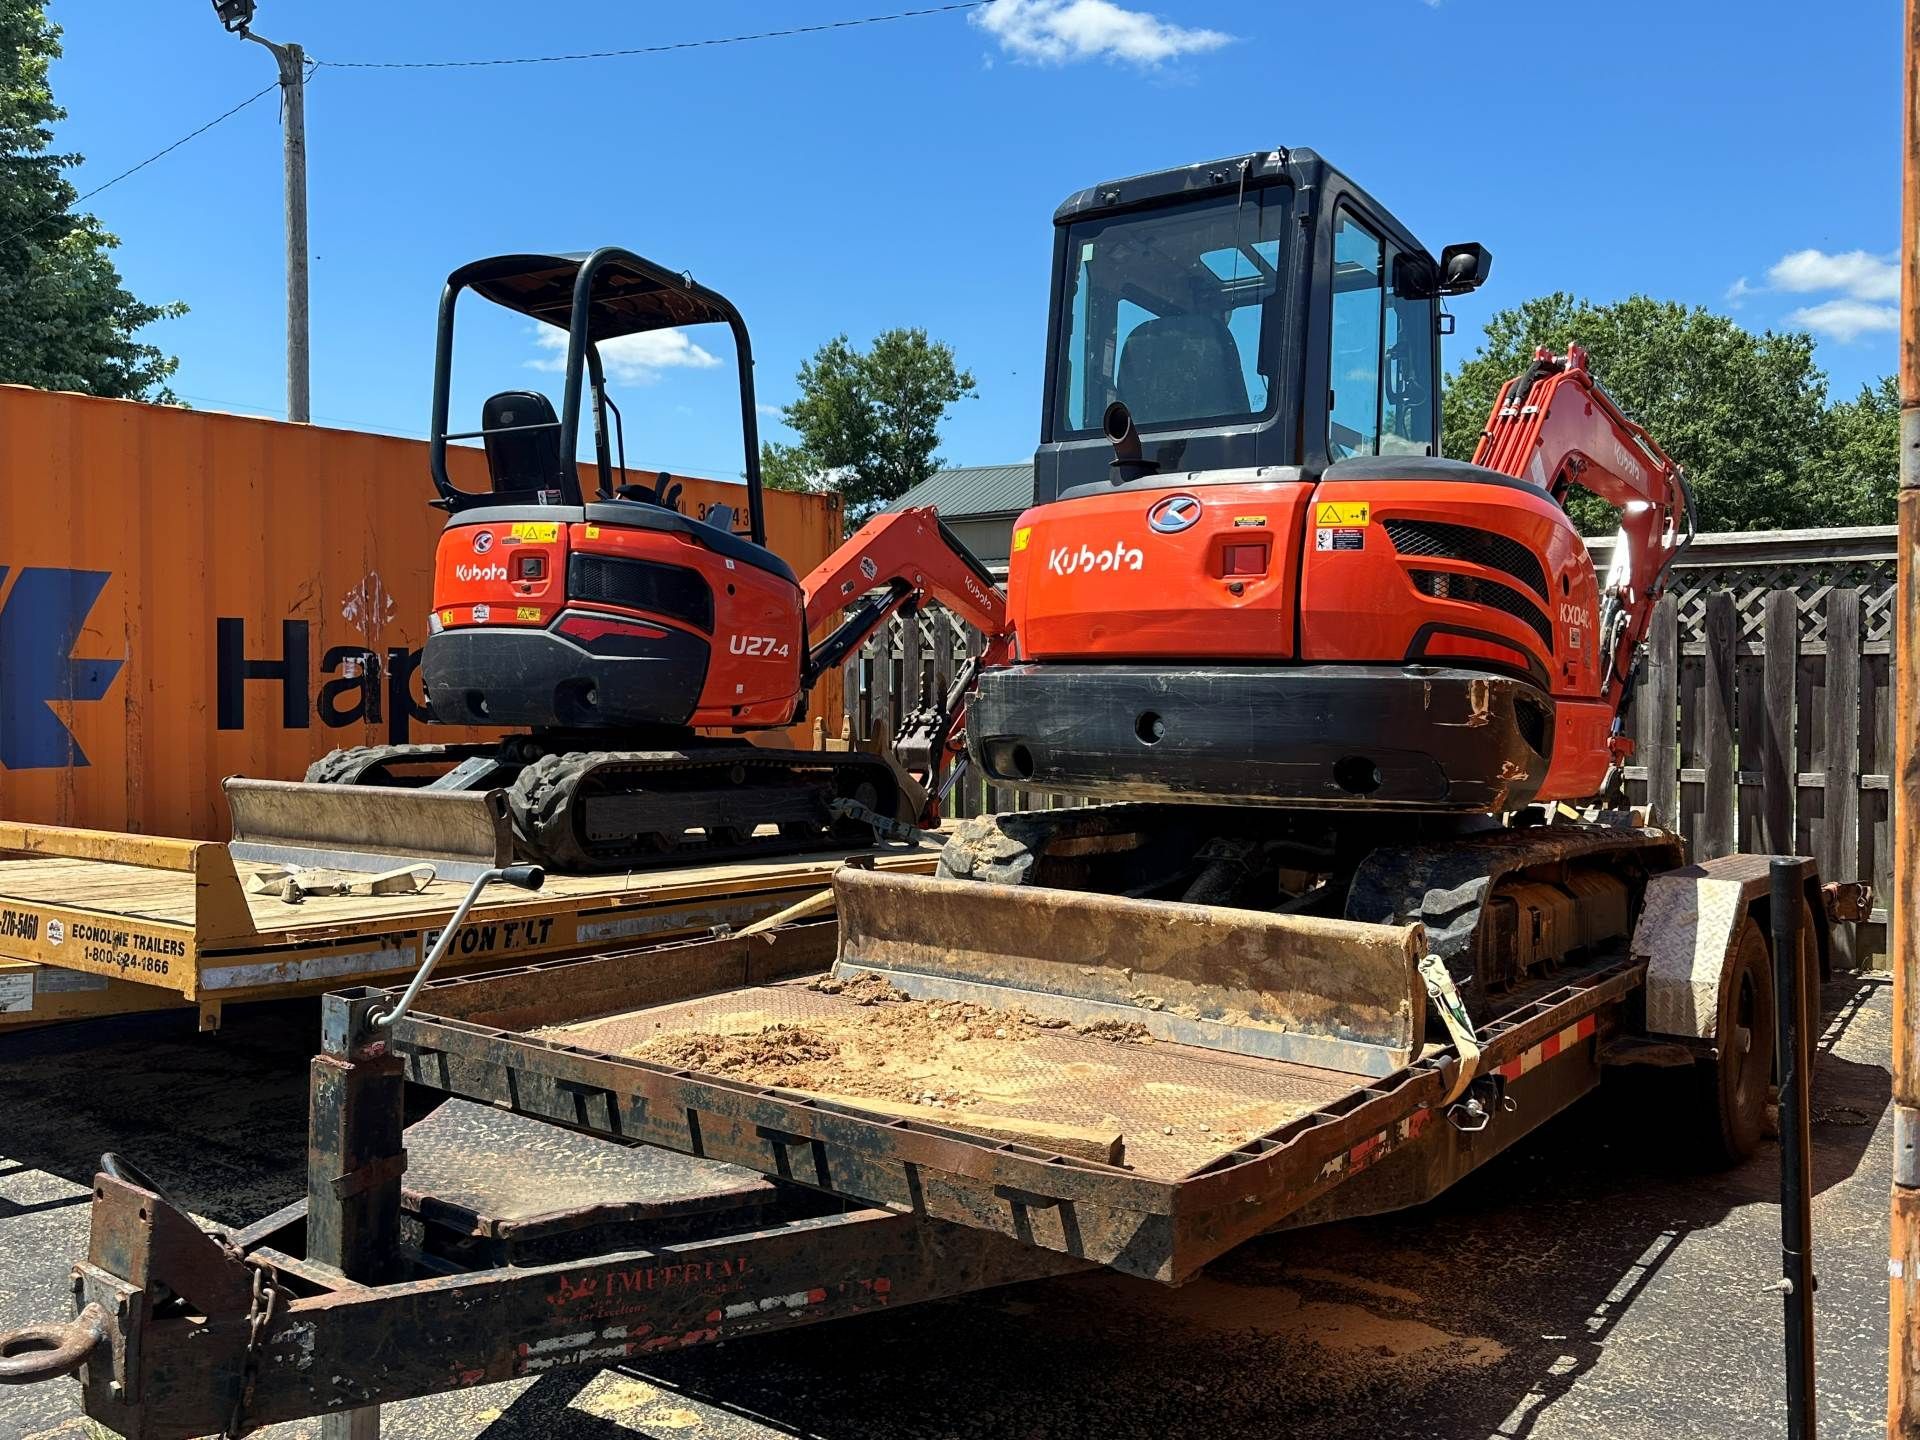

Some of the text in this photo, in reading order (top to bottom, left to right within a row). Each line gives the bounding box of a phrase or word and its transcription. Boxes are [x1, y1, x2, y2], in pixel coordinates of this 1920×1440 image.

[456, 563, 508, 581] Kubota
[1048, 541, 1144, 576] Kubota
[964, 575, 992, 610] Kubota
[729, 634, 789, 657] U27-4
[217, 617, 438, 746] Hap
[133, 934, 185, 957] TRAILERS
[503, 917, 554, 949] TLT
